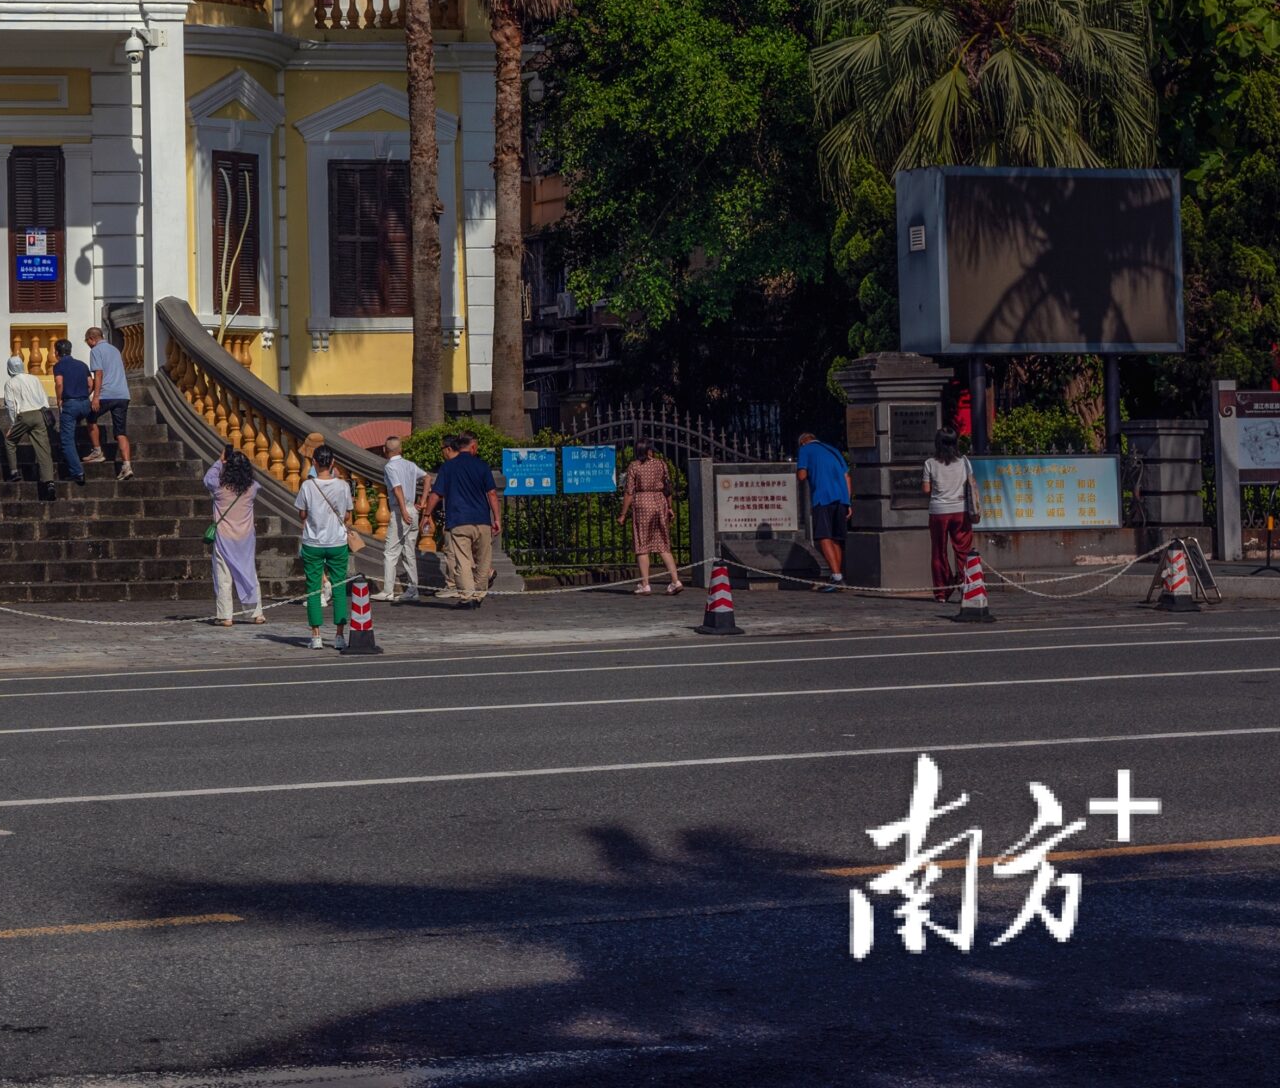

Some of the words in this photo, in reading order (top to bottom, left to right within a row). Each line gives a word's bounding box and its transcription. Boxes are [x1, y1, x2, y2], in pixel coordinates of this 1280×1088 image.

[571, 450, 606, 460] 温馨提示
[734, 480, 787, 488] 全国重点文物保护单位
[1047, 479, 1065, 489] 文明
[1077, 479, 1096, 489] 和谐
[1047, 493, 1064, 503] 公正
[1077, 493, 1096, 503] 法治
[1015, 508, 1033, 518] 敬业
[1047, 508, 1064, 517] 诚信
[1077, 507, 1096, 517] 友善
